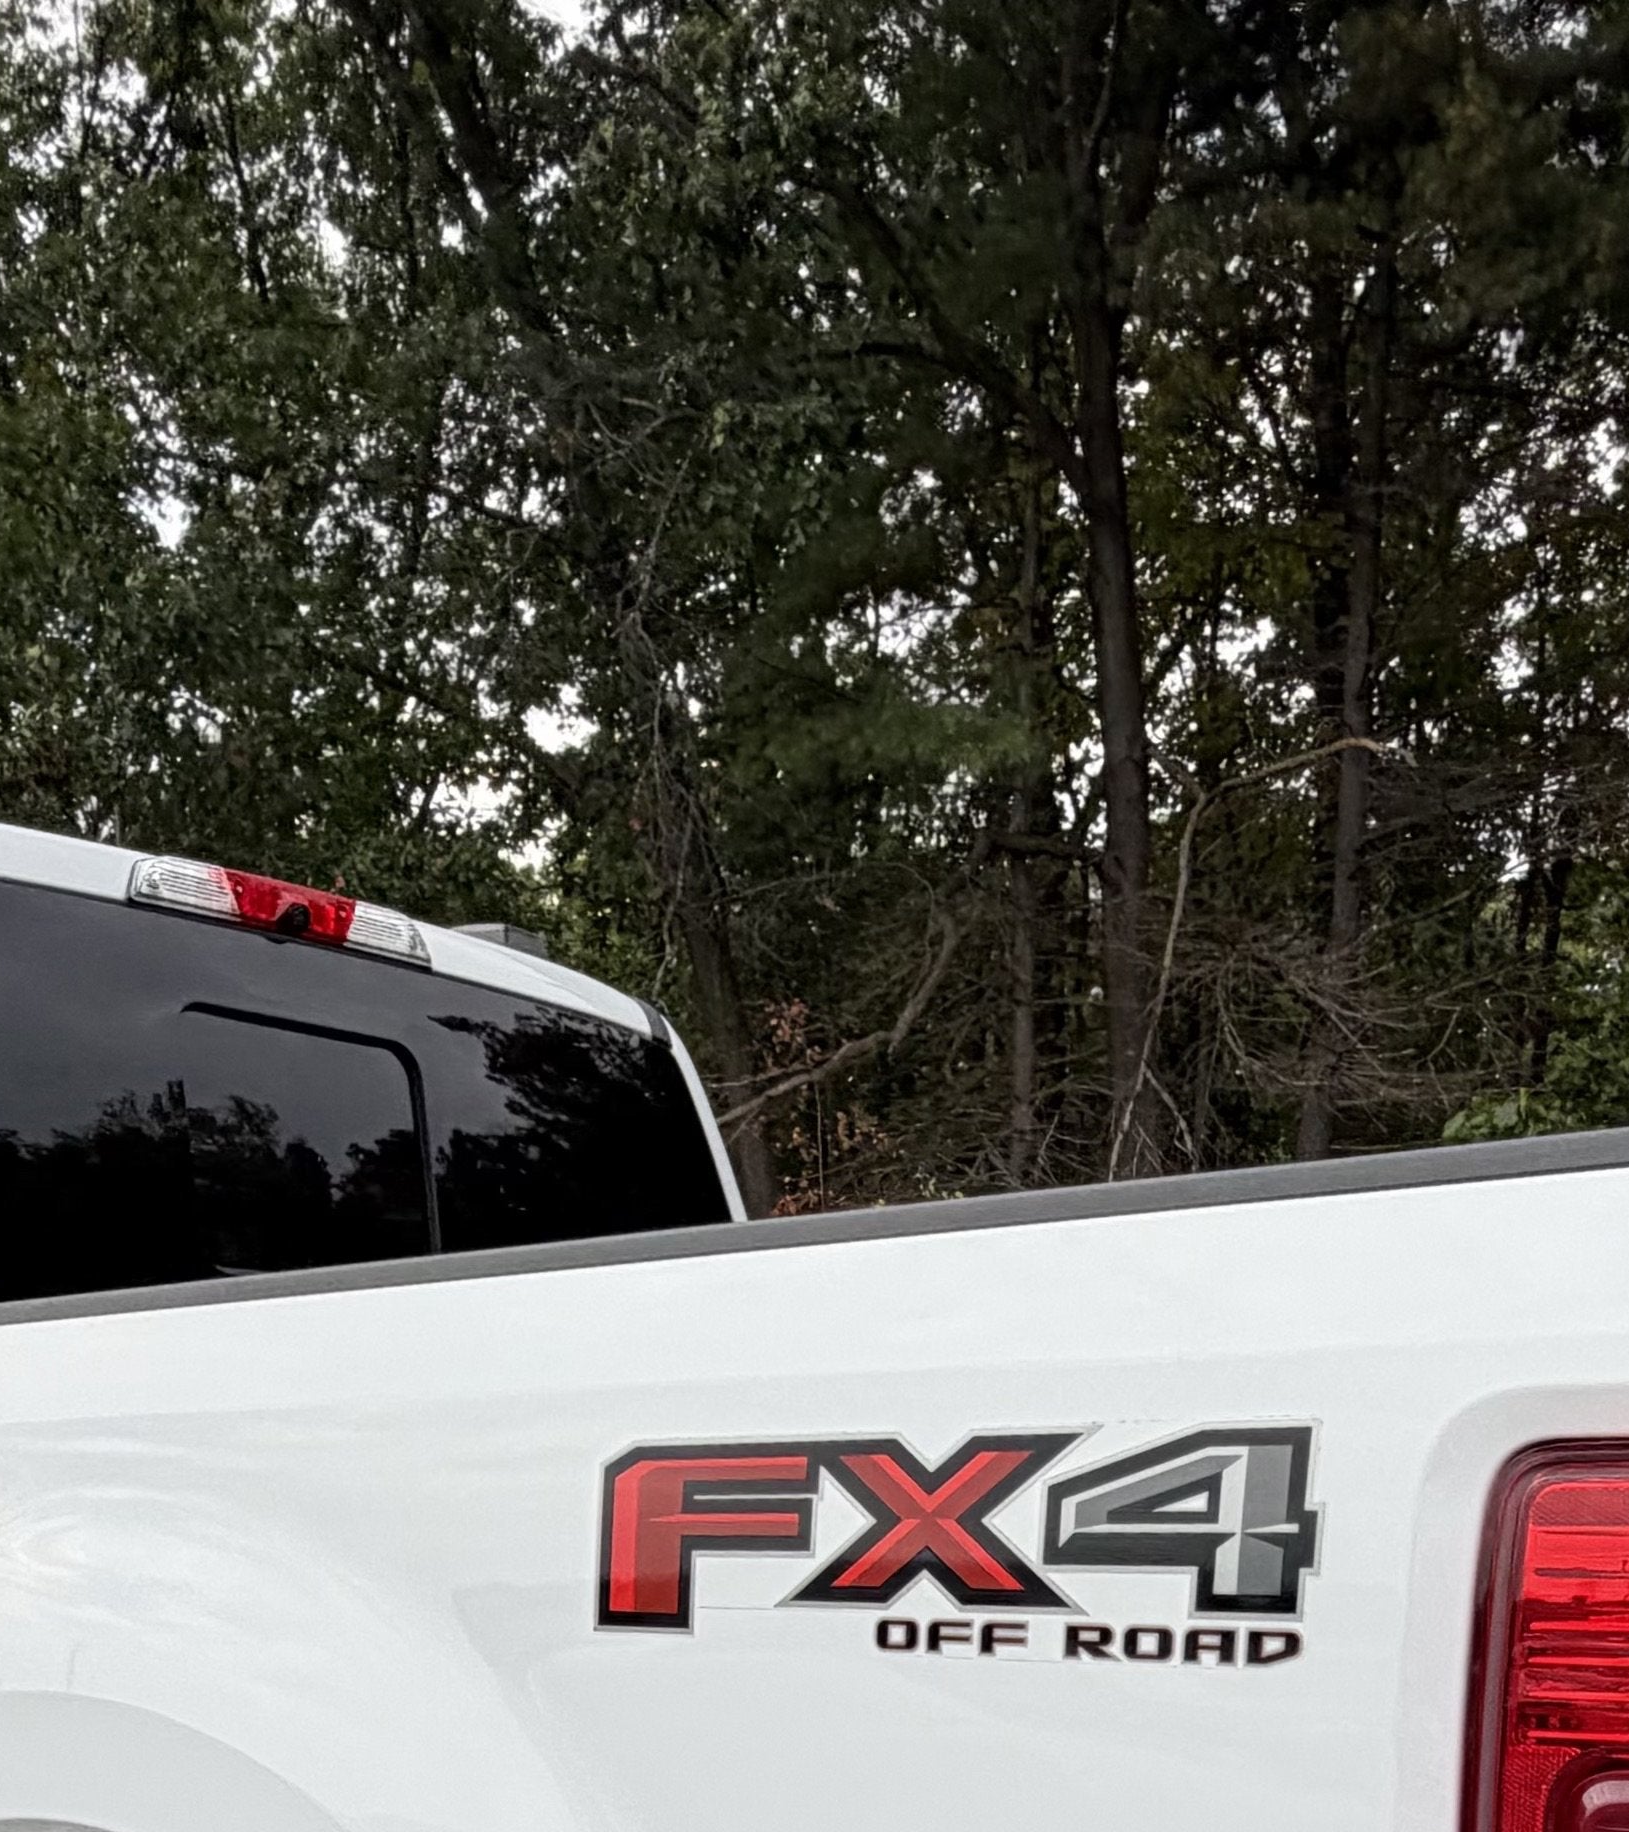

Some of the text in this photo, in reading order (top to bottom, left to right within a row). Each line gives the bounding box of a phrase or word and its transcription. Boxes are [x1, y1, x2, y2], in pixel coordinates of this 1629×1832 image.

[594, 1417, 1324, 1634] FX4
[875, 1618, 1304, 1668] OFF ROAD
